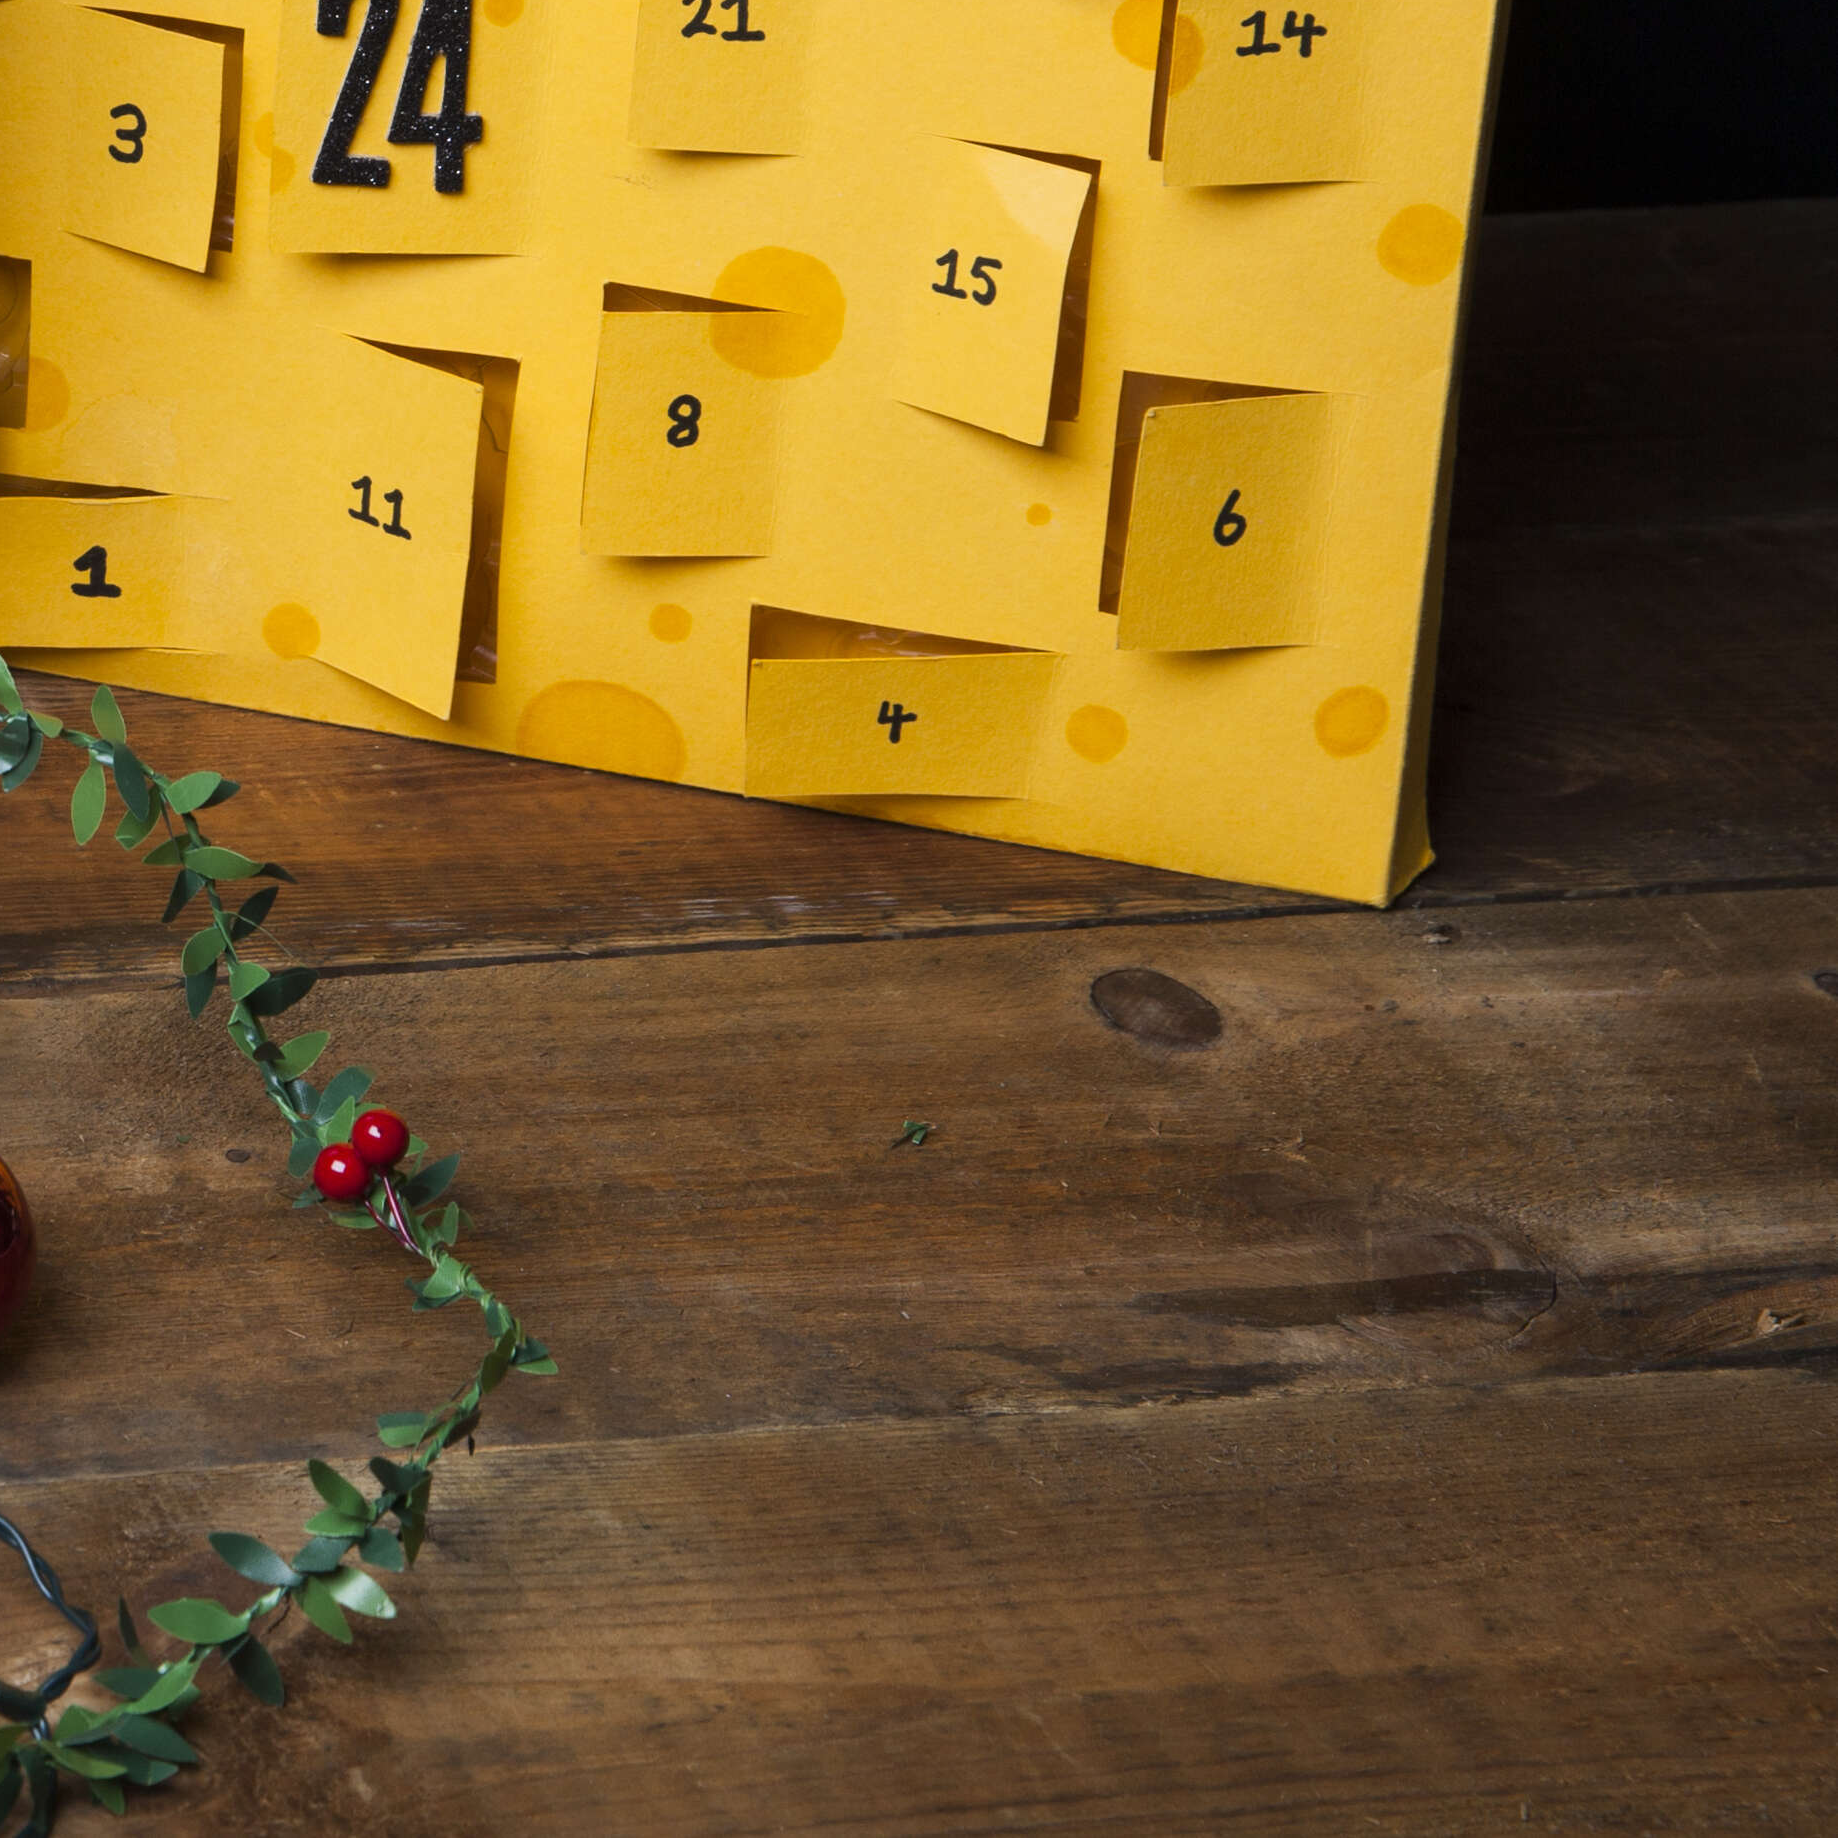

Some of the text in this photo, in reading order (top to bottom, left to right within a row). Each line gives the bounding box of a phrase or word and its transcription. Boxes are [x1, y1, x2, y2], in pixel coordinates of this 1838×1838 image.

[1235, 10, 1328, 59] 14
[108, 103, 148, 164] 3
[932, 249, 1003, 307] 15
[666, 394, 703, 449] 8
[348, 475, 412, 541] 11
[1213, 489, 1248, 547] 6
[70, 544, 123, 599] 1
[877, 700, 918, 745] 4
